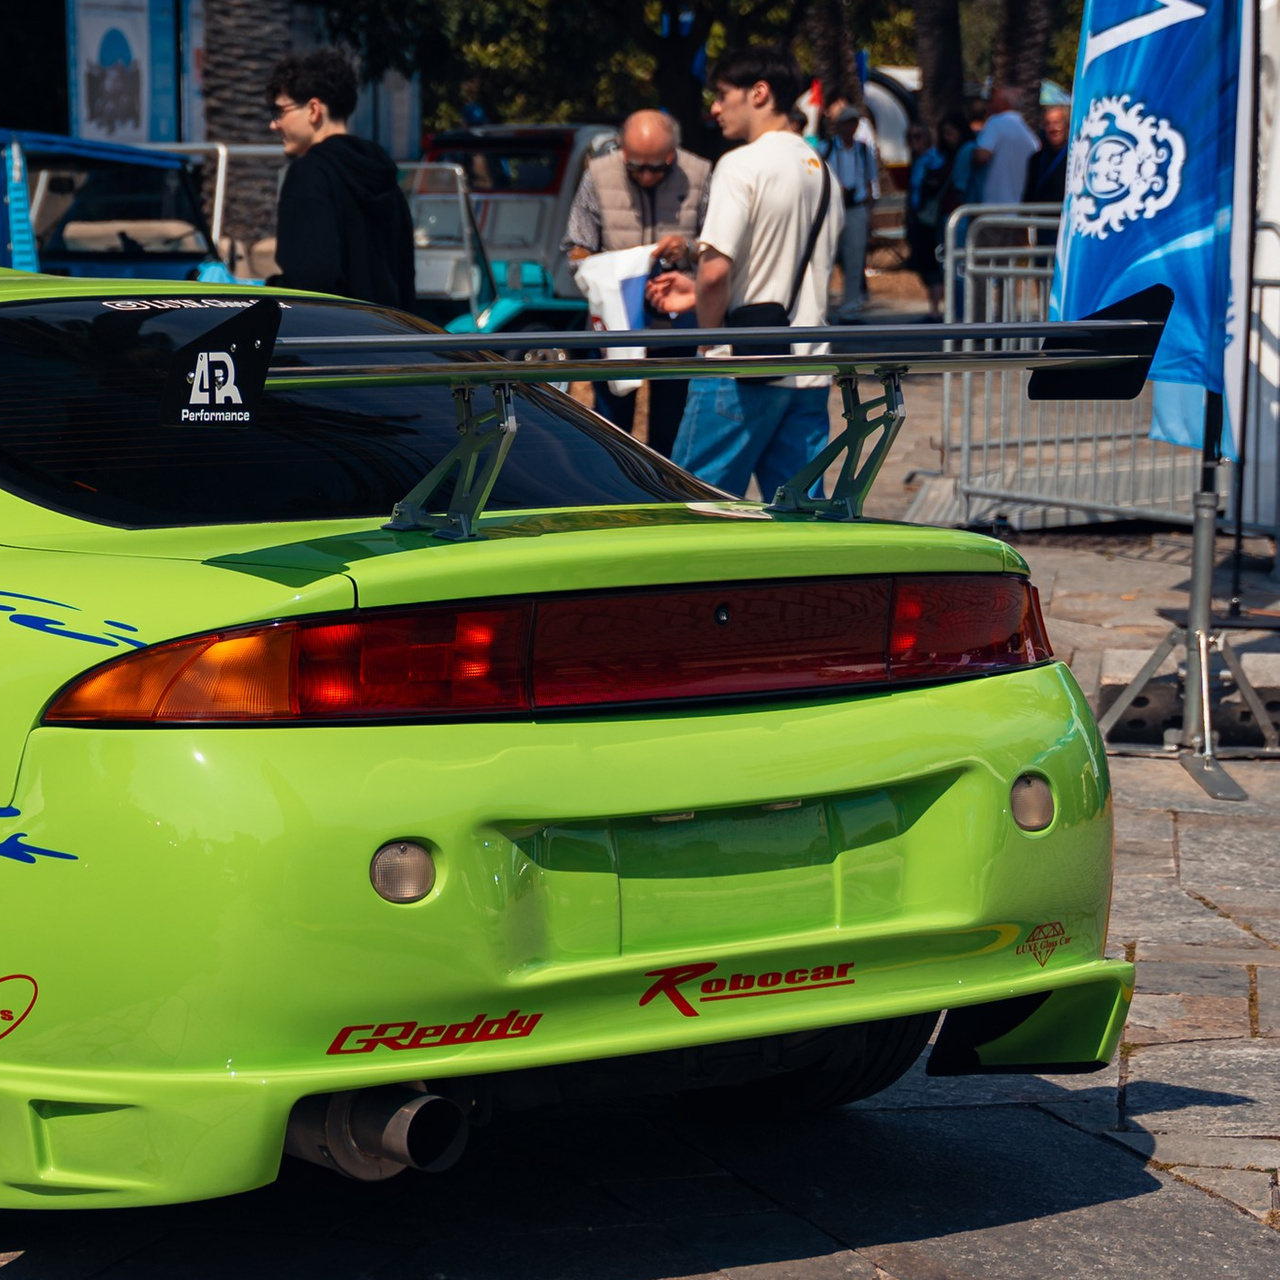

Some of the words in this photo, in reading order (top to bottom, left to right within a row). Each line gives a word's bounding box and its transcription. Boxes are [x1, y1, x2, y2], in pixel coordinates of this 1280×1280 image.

[181, 409, 250, 421] Performance
[639, 962, 855, 1017] Robocar
[326, 1009, 544, 1055] GReddy
